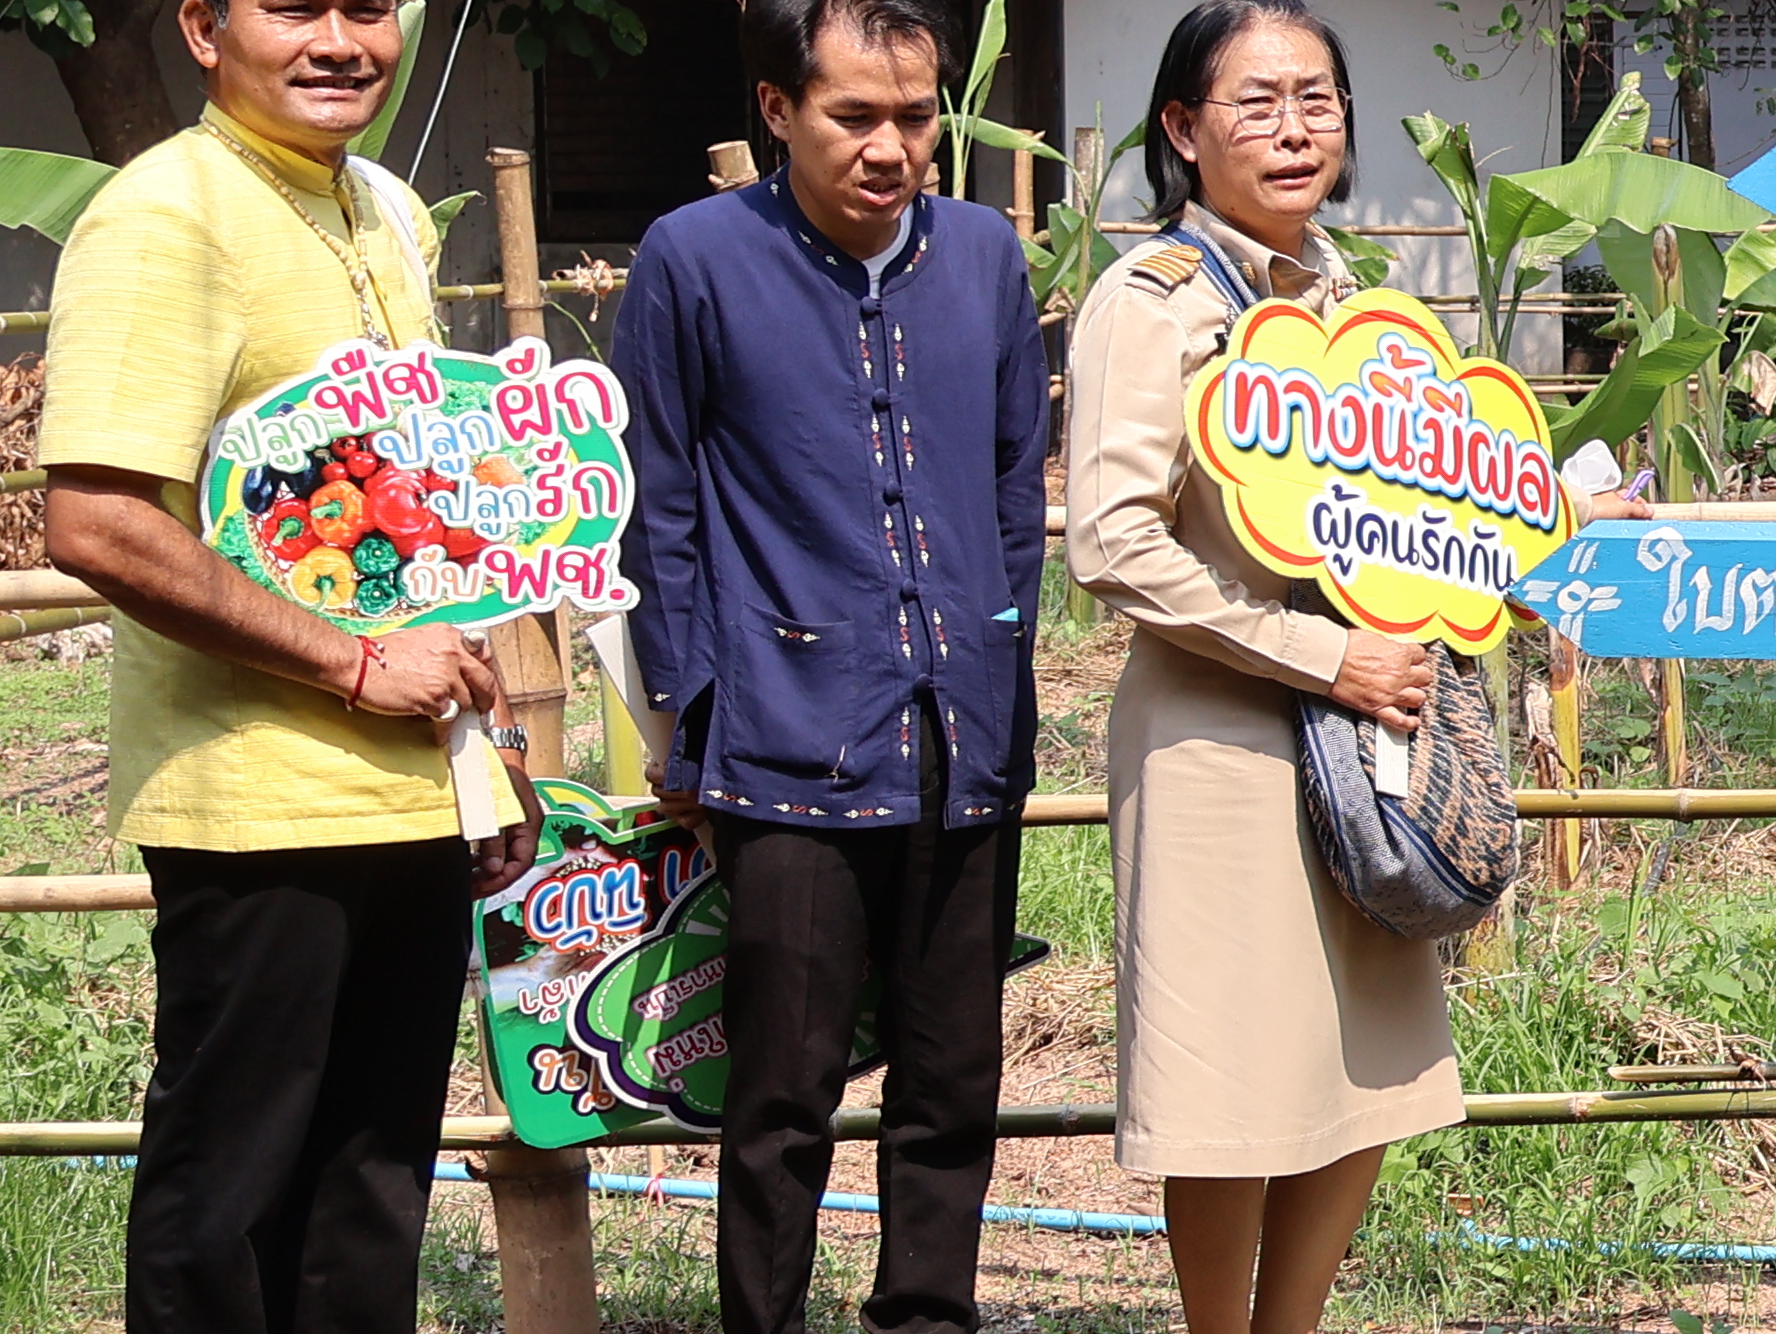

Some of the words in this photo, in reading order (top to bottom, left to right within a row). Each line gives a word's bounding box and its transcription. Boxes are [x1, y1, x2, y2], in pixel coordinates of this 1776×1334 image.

[1235, 343, 1552, 520] ทางนี้มีผล
[1313, 484, 1514, 593] ผู้คนรักกัน
